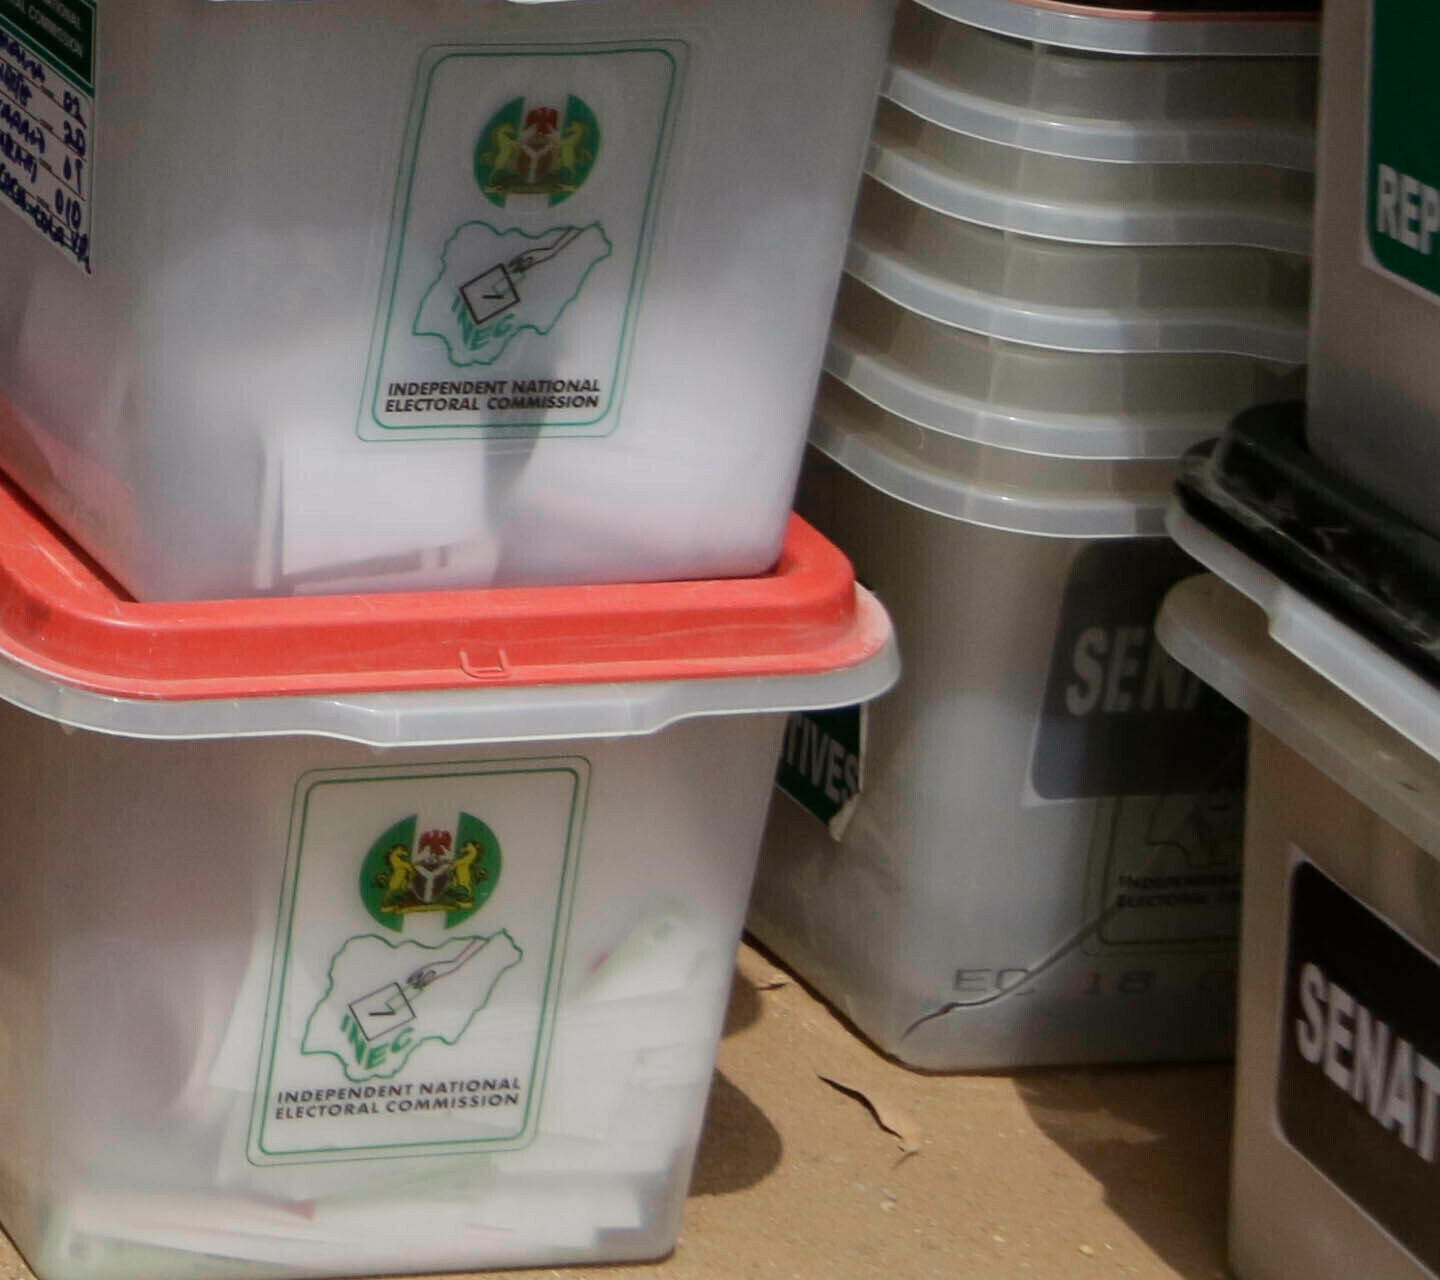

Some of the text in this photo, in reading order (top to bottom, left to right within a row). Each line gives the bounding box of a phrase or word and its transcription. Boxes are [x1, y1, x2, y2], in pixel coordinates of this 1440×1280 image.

[388, 378, 601, 397] INDEPENDENT NATIONAL
[384, 395, 599, 413] ELECTORAL COMMISSION
[277, 1077, 521, 1105] INDEPENDENT NATIONAL
[275, 1093, 520, 1120] ELECTORAL COMMISSION
